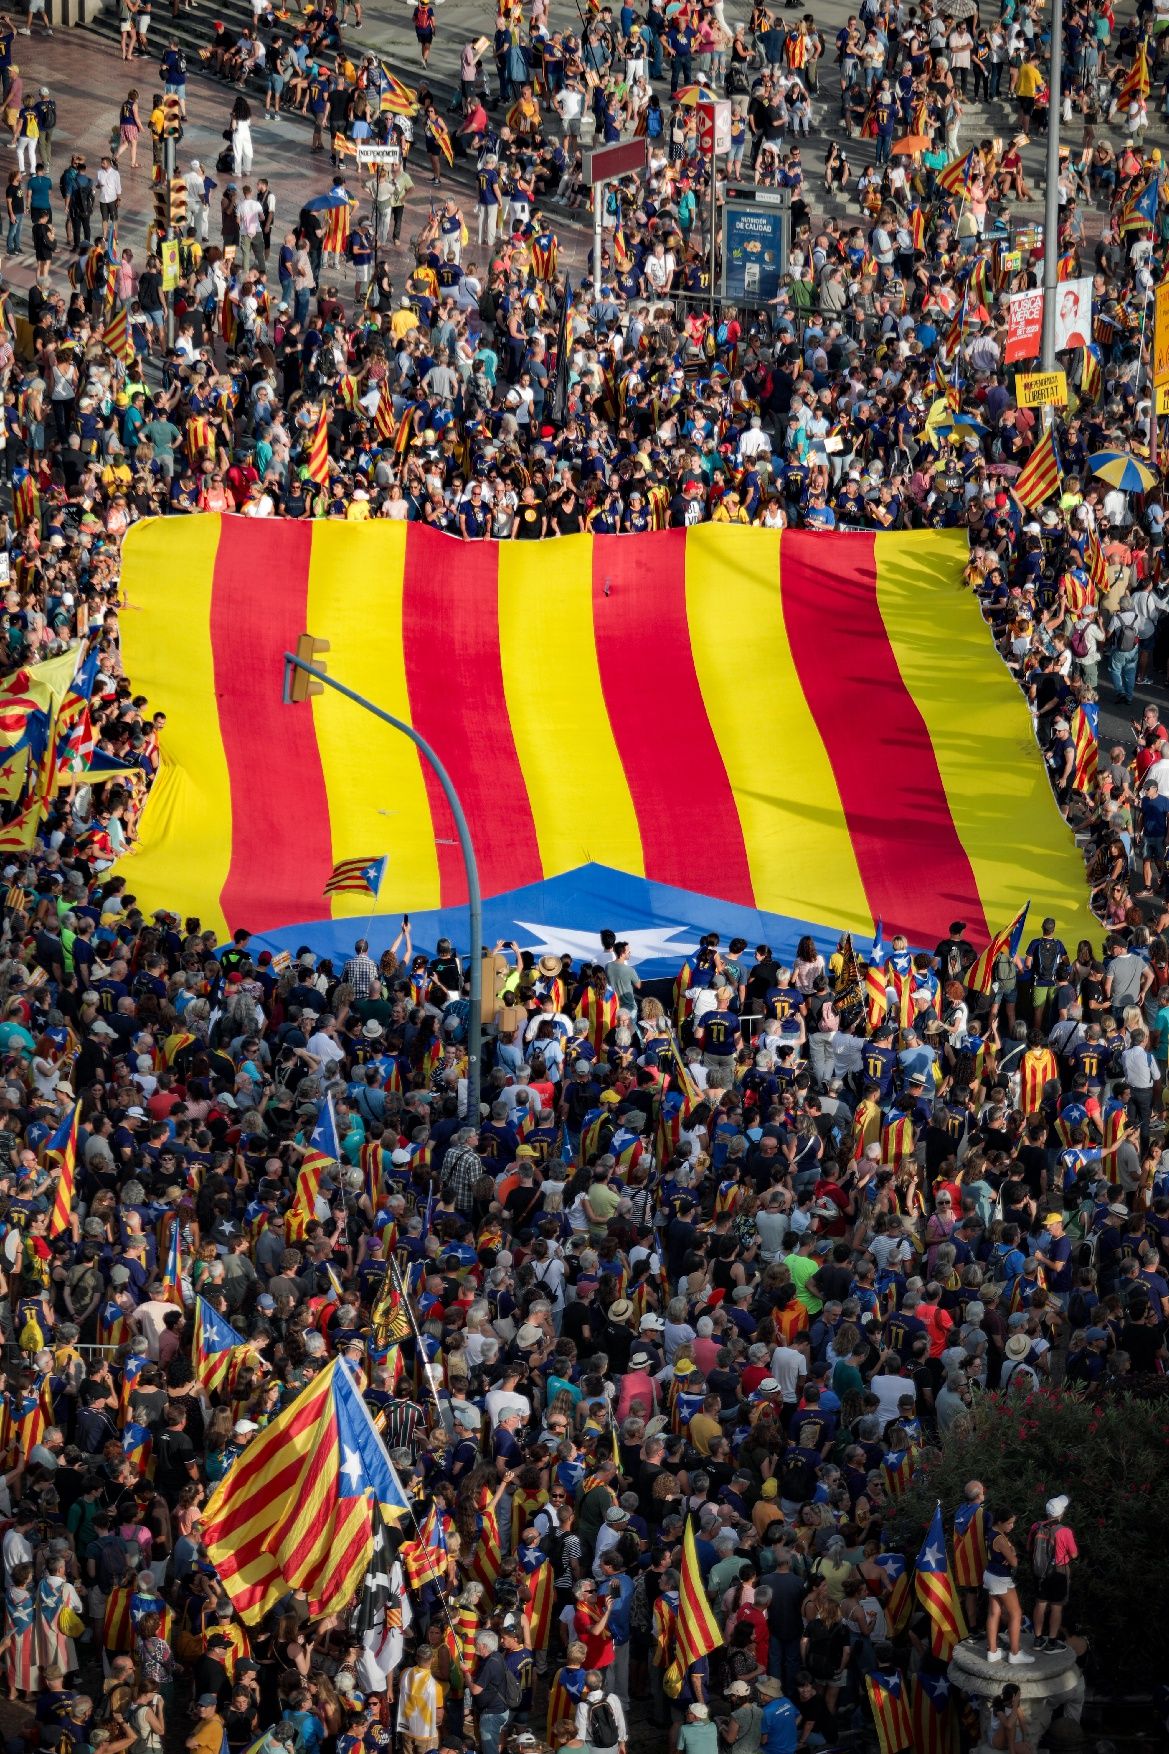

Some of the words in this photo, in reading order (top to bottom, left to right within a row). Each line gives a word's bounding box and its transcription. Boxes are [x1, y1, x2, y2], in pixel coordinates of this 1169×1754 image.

[879, 110, 888, 125] 11
[745, 222, 772, 232] CALIDAD
[775, 1002, 788, 1020] 11
[711, 1025, 724, 1042] 11
[868, 1059, 881, 1078] 11
[1083, 1058, 1097, 1076] 11
[890, 1326, 902, 1349] 11
